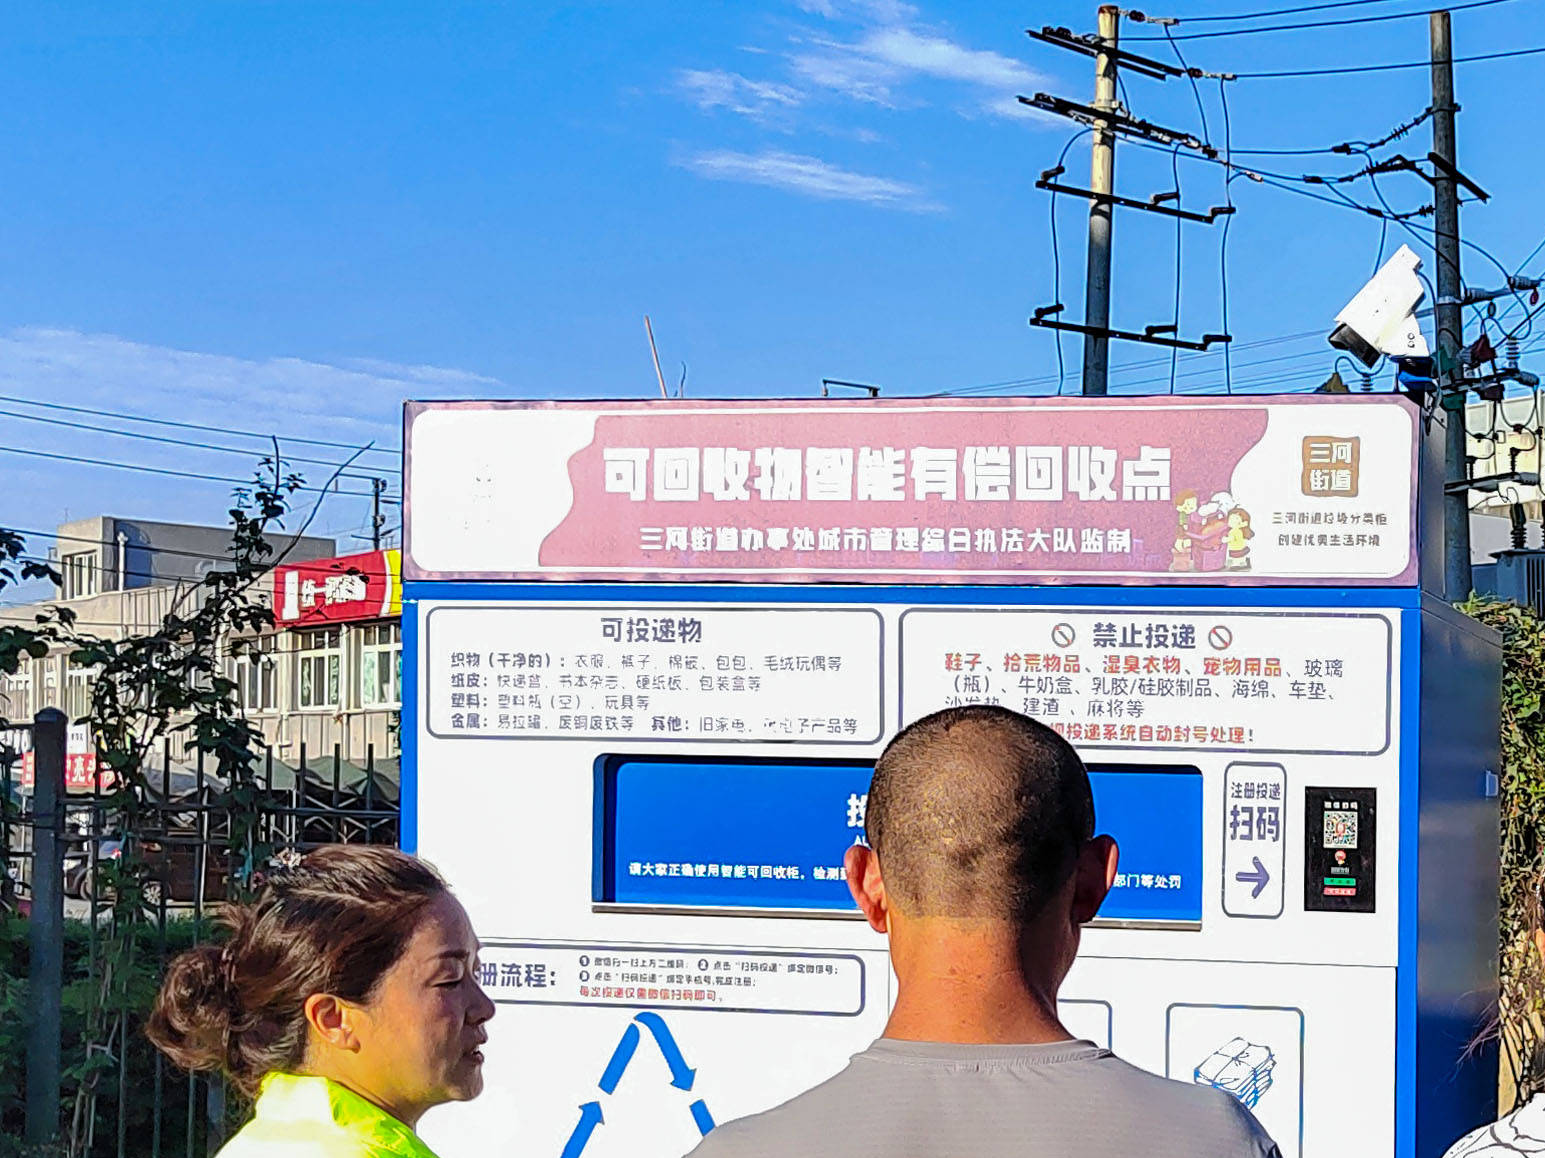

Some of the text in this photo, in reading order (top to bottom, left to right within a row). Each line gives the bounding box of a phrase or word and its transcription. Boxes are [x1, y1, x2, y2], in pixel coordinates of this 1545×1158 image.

[1309, 442, 1352, 463] 三河
[603, 446, 1171, 501] 可回收物智能有偿回收点
[1309, 469, 1351, 491] 街道
[639, 526, 1131, 554] 三河街道办事处城市管理综合执法大队监制
[1278, 533, 1380, 547] 创建优美生活环境
[601, 617, 702, 643] 可投递物
[1093, 622, 1196, 649] 禁止投递
[1230, 782, 1281, 800] 注册投递
[1230, 804, 1280, 842] 扫码
[479, 962, 556, 988] 册流程：
